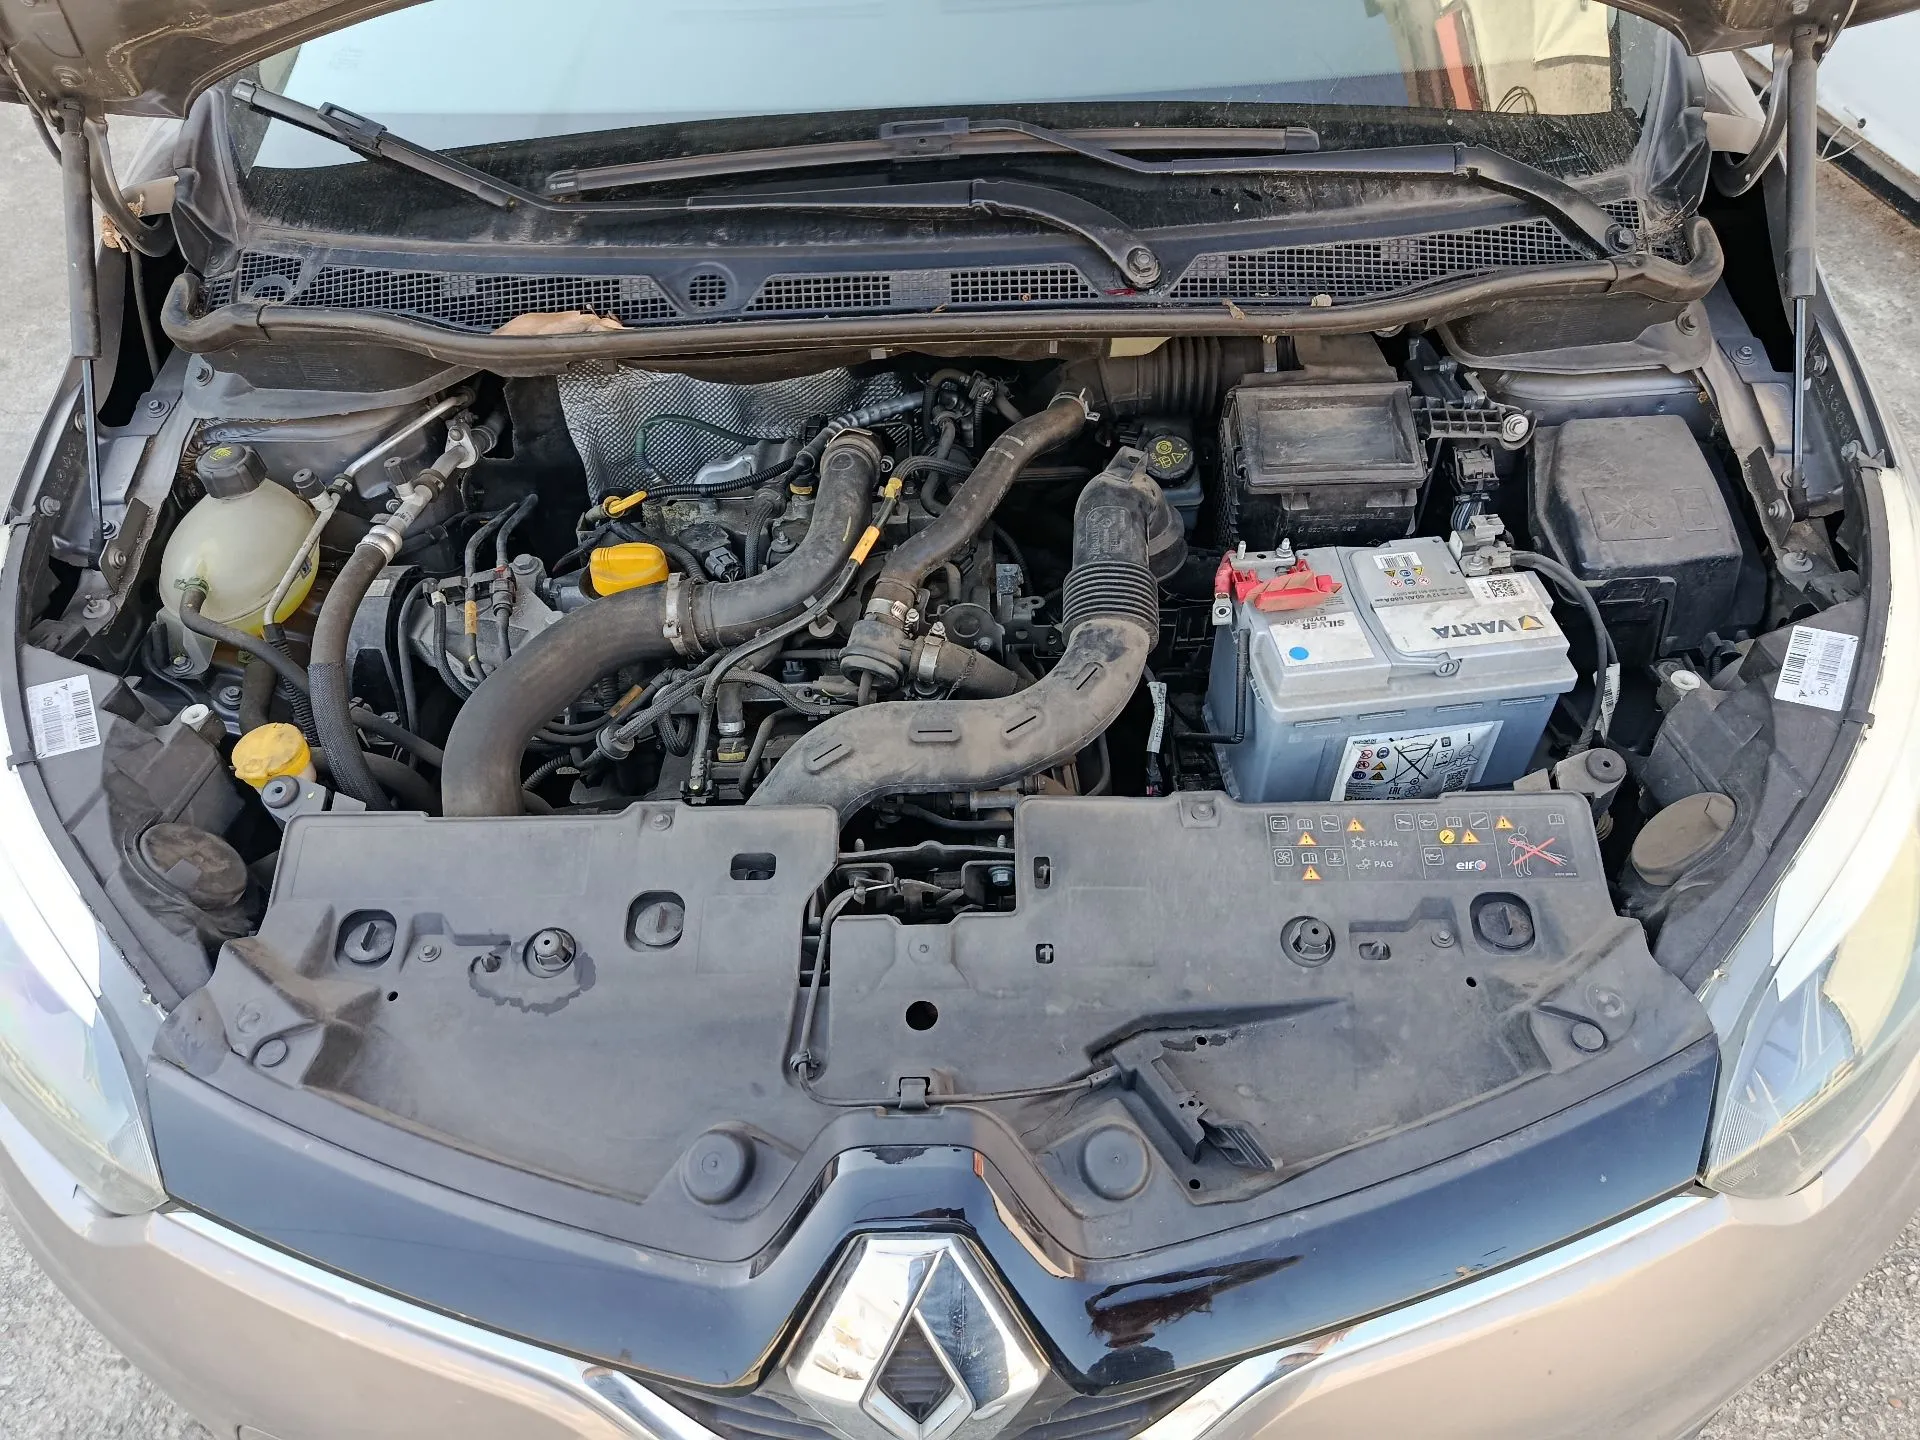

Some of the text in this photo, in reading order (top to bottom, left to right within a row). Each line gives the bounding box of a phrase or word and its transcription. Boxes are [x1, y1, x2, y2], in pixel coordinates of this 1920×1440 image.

[1302, 619, 1345, 630] SILVER
[1430, 619, 1517, 639] VARTA
[1369, 839, 1398, 847] R-134a
[1374, 860, 1394, 868] PAG
[1456, 861, 1475, 870] elf
